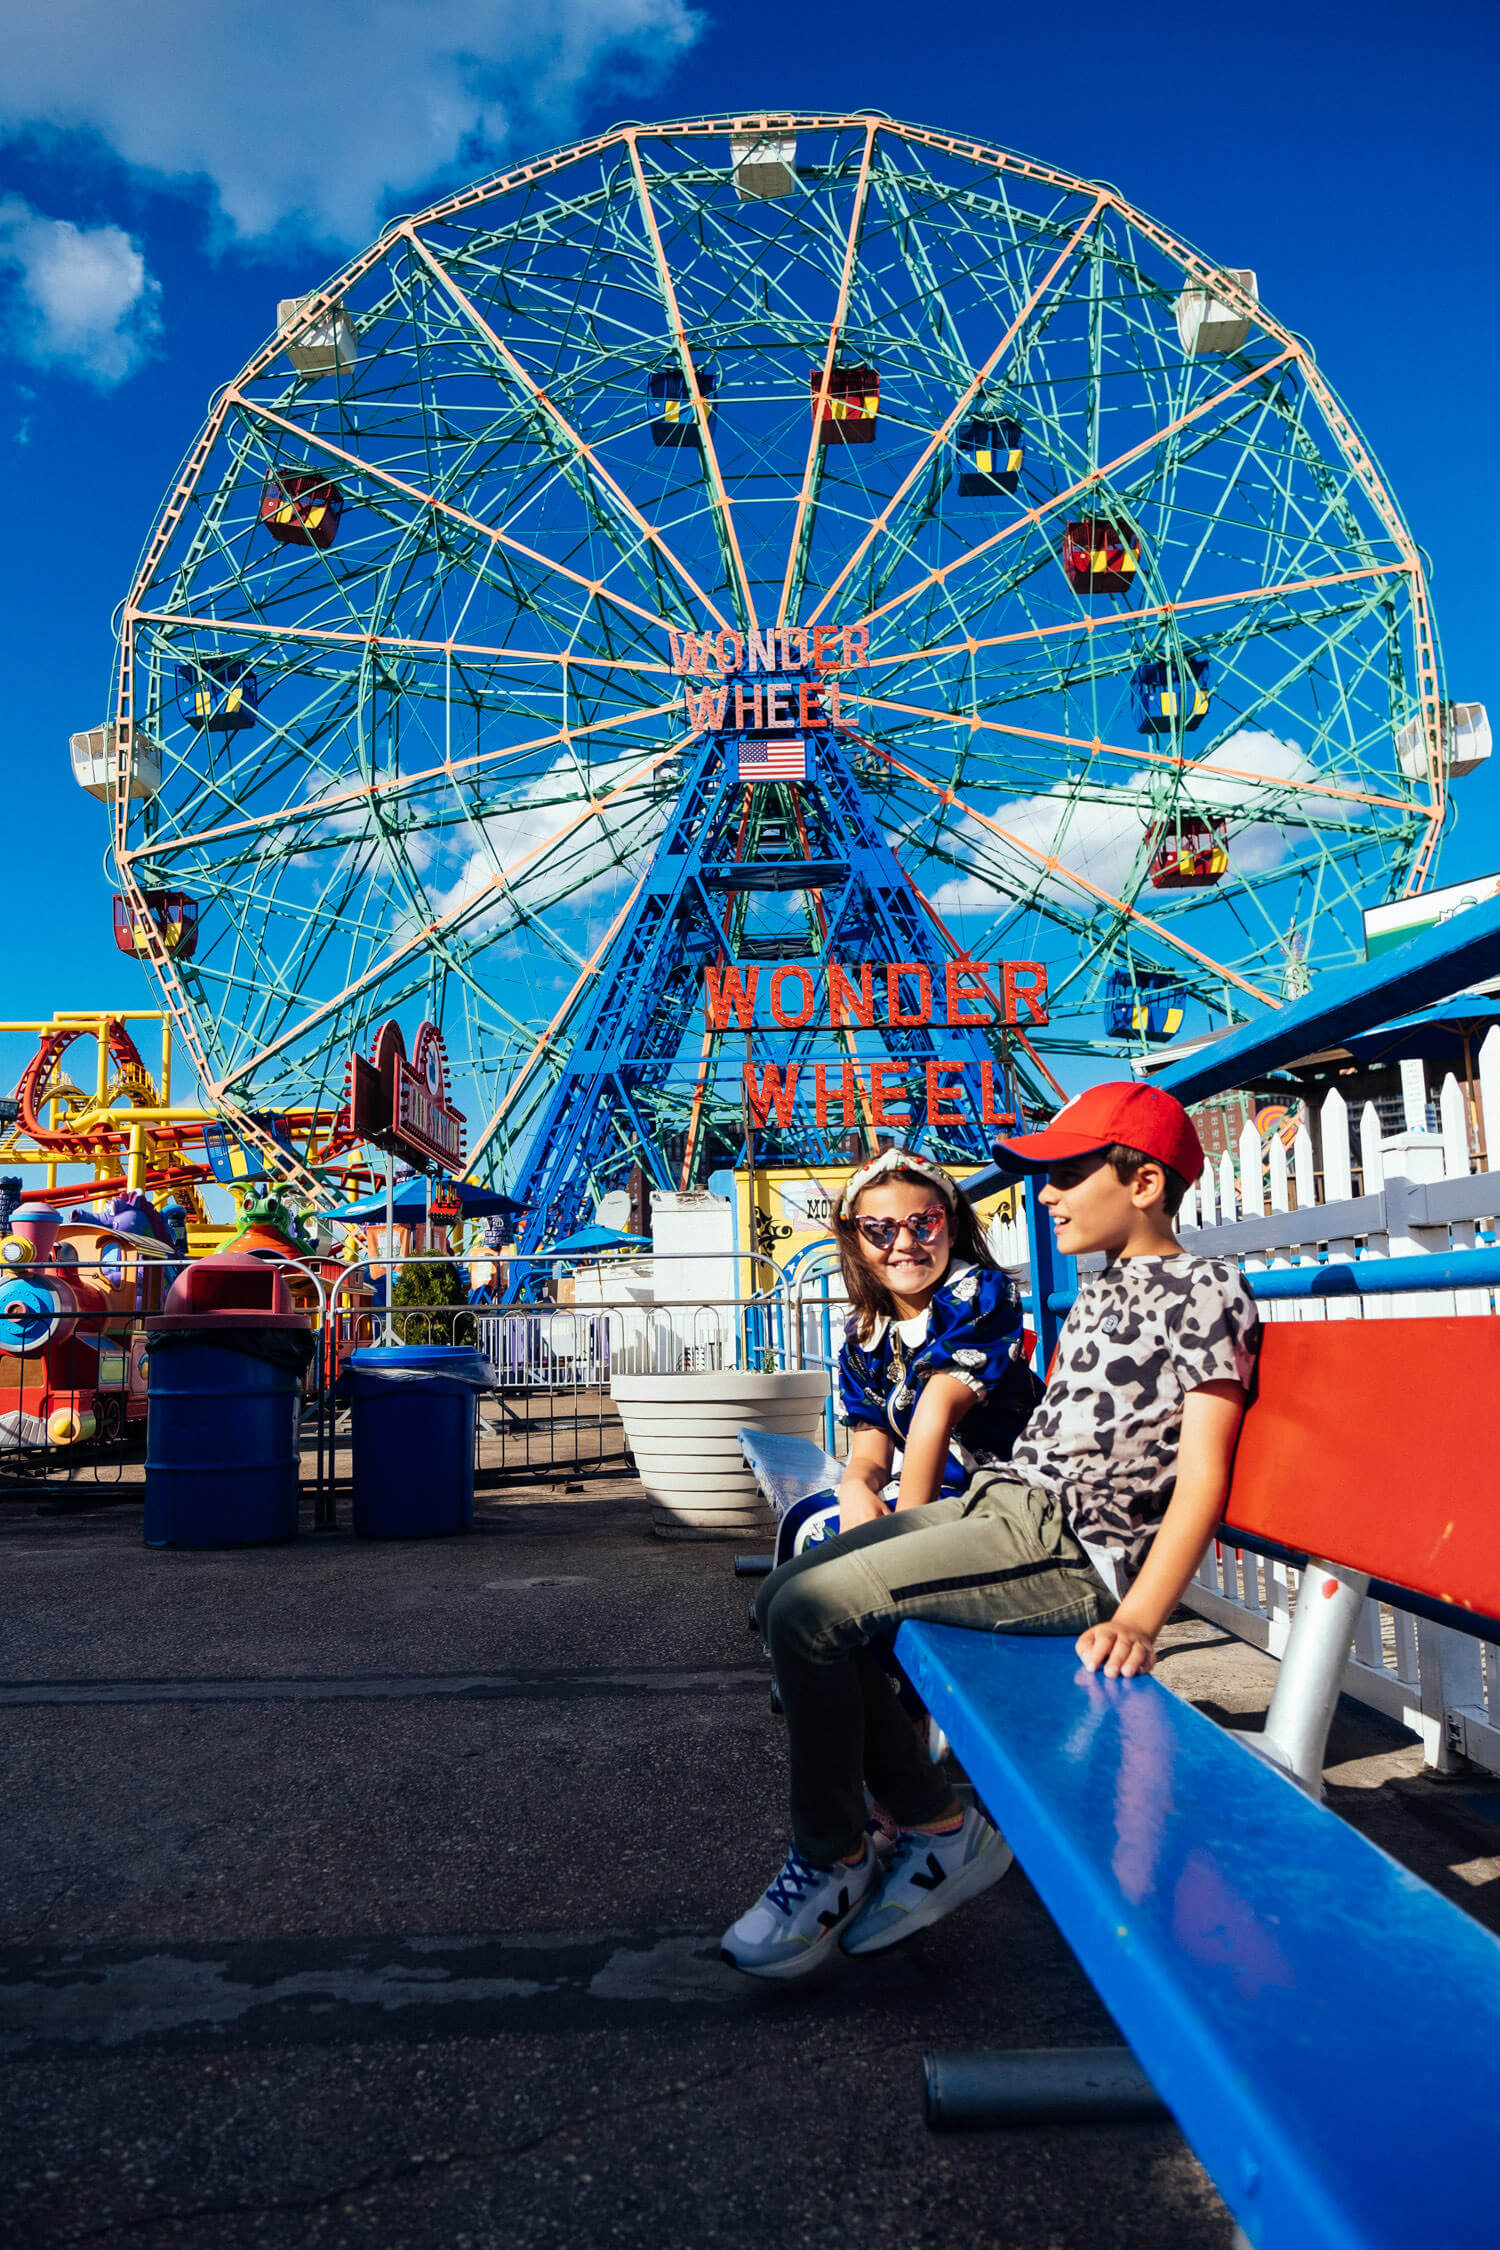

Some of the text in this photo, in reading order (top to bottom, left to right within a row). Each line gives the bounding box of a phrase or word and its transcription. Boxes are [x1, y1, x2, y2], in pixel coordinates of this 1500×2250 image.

[669, 625, 870, 674] WONDER
[685, 682, 859, 730] WHEEL
[704, 961, 1049, 1029] WONDER
[744, 1060, 1017, 1127] WHEEL
